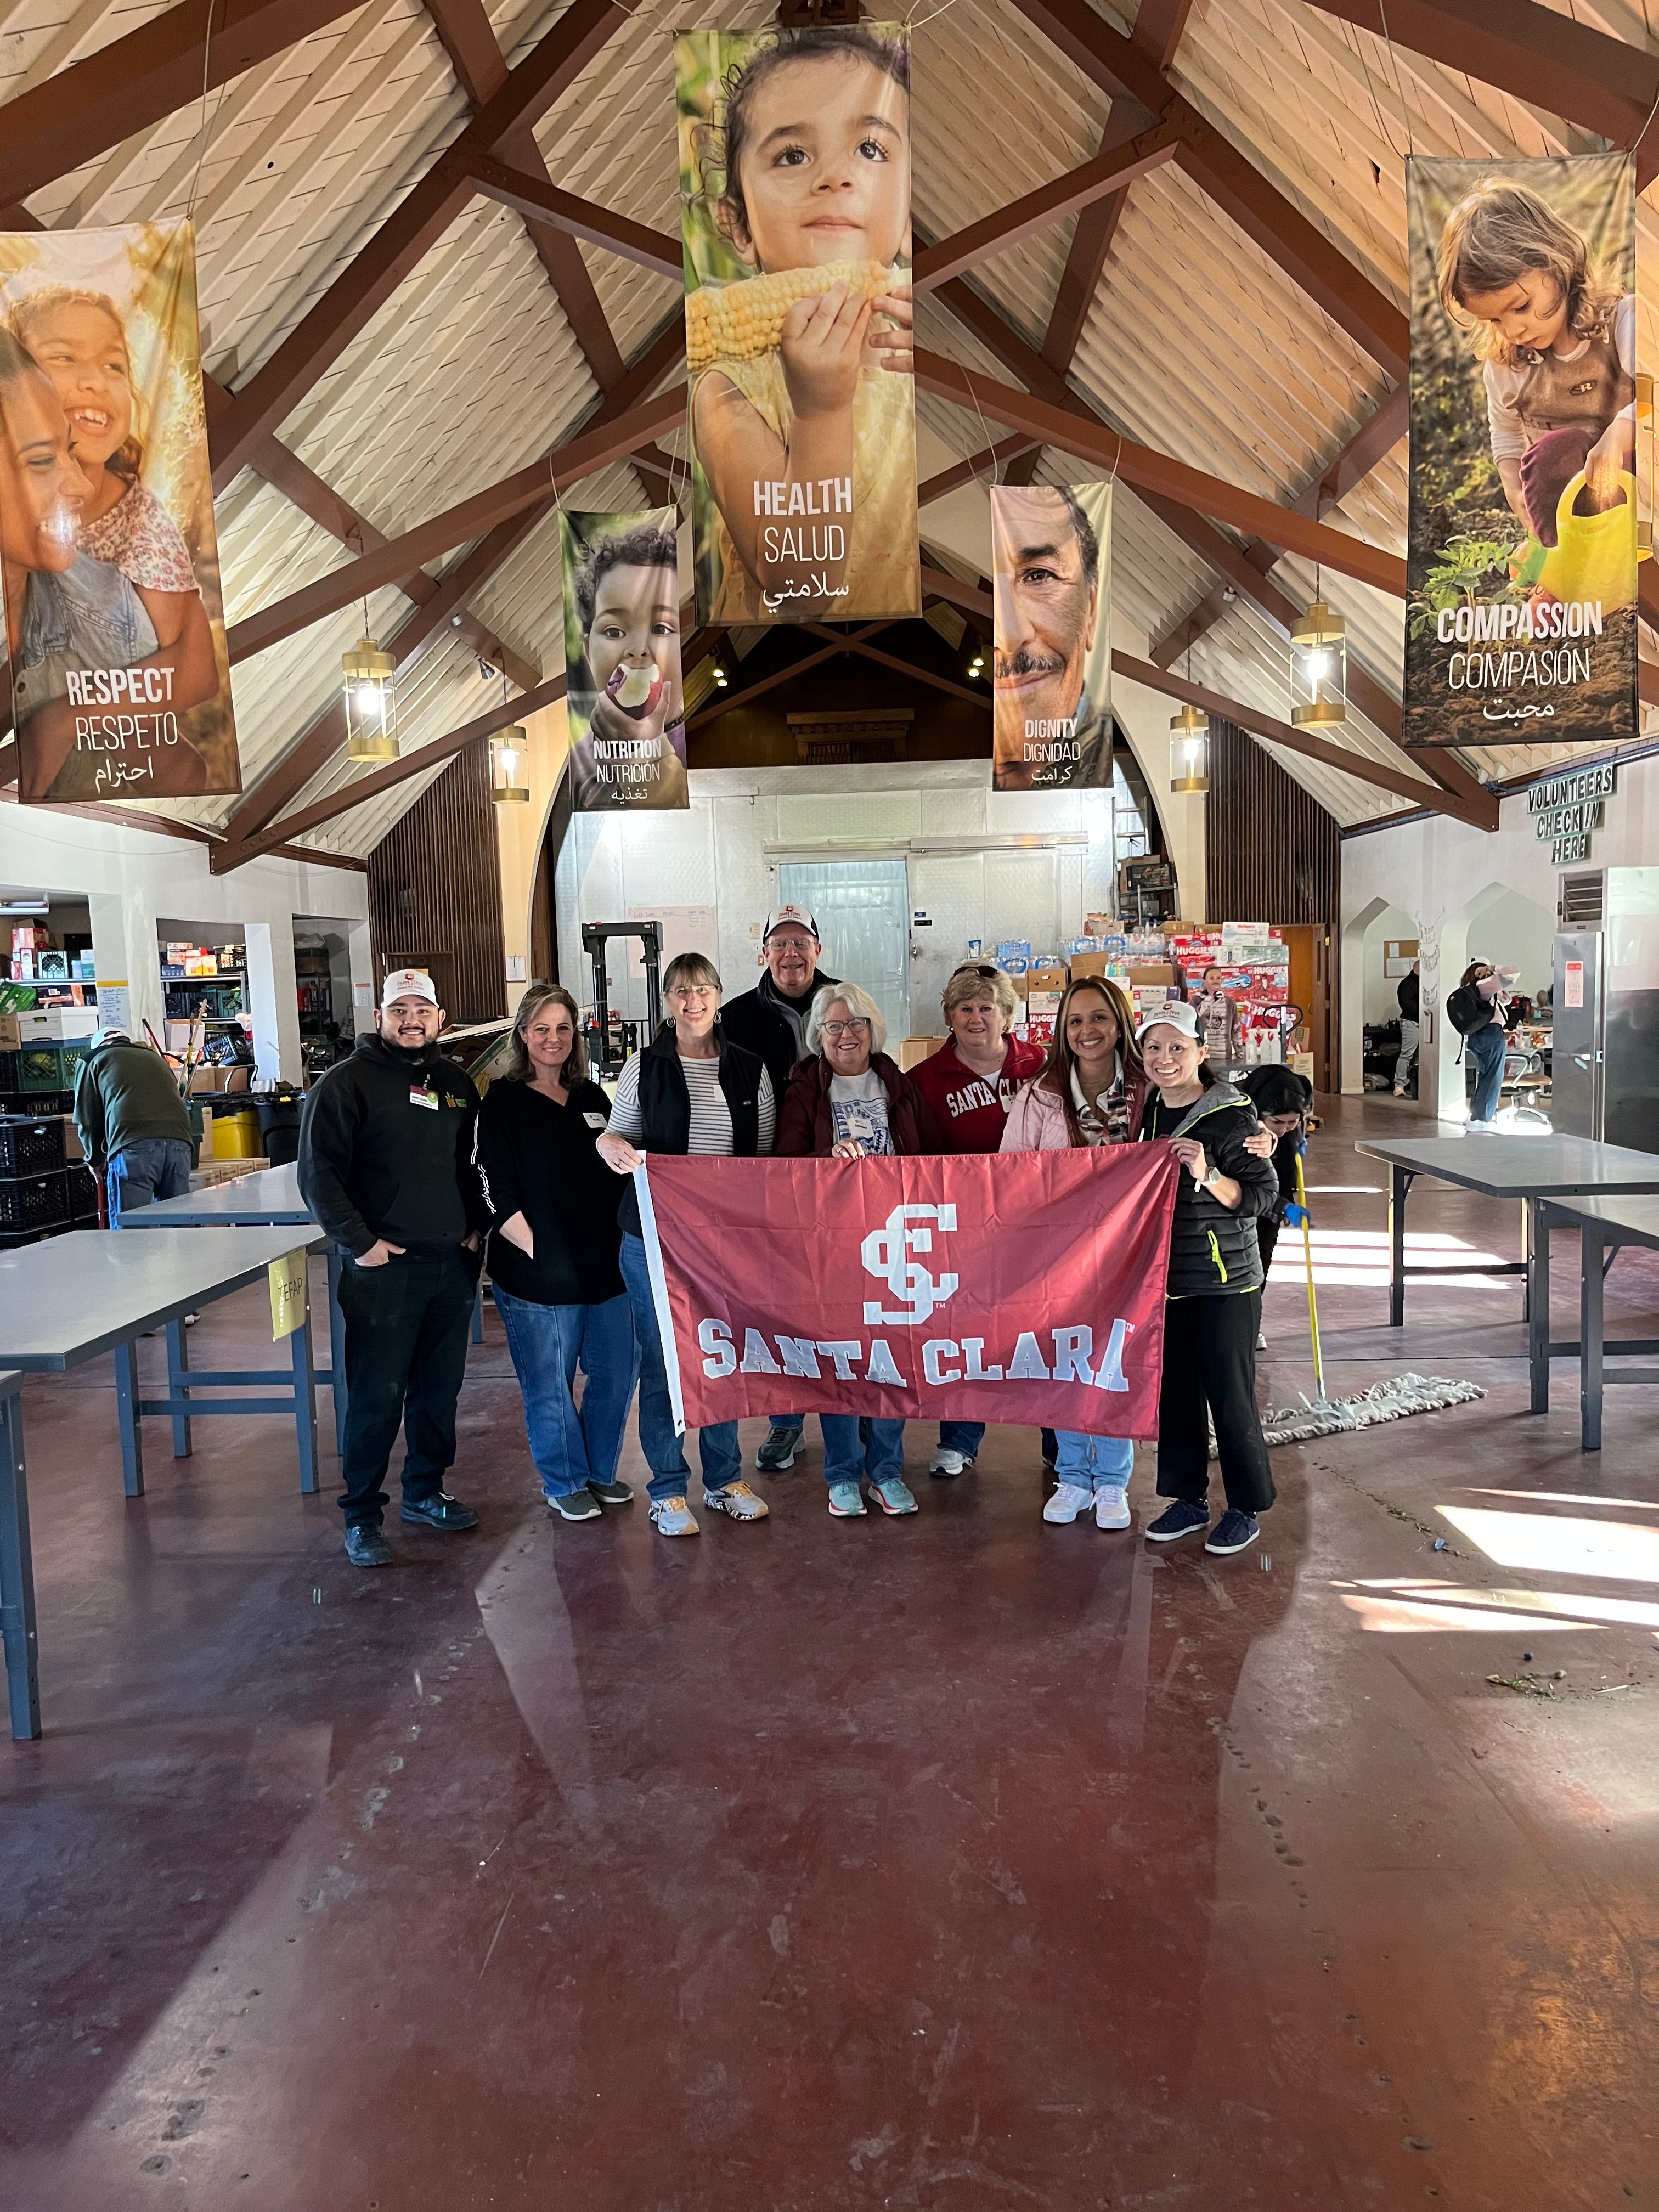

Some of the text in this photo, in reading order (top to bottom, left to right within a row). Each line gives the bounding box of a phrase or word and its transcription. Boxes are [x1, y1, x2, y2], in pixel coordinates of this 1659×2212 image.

[753, 477, 852, 516] HEALTH
[764, 525, 845, 563] SALUD
[1437, 601, 1602, 643] COMPASSION
[1448, 643, 1590, 689] COMPASIÓN
[66, 667, 175, 706] RESPECT
[75, 712, 178, 751] RESPETO
[1025, 718, 1078, 738] DIGNITY
[1483, 699, 1555, 727] محبت
[594, 739, 662, 759] NUTRITION
[1023, 742, 1081, 762] DIGNIDAD
[95, 755, 153, 794] احترام
[597, 760, 660, 783] NUTRICIÓN
[1528, 767, 1612, 811] VOLUNTEERS
[1537, 801, 1599, 839] CHECK IN
[1551, 833, 1585, 863] HERE
[1176, 946, 1213, 956] HUGGIES
[1254, 966, 1288, 975] HUGGIES
[946, 1081, 996, 1118] SANTA
[698, 1318, 907, 1387] SANTA
[922, 1318, 1130, 1392] CLARA
